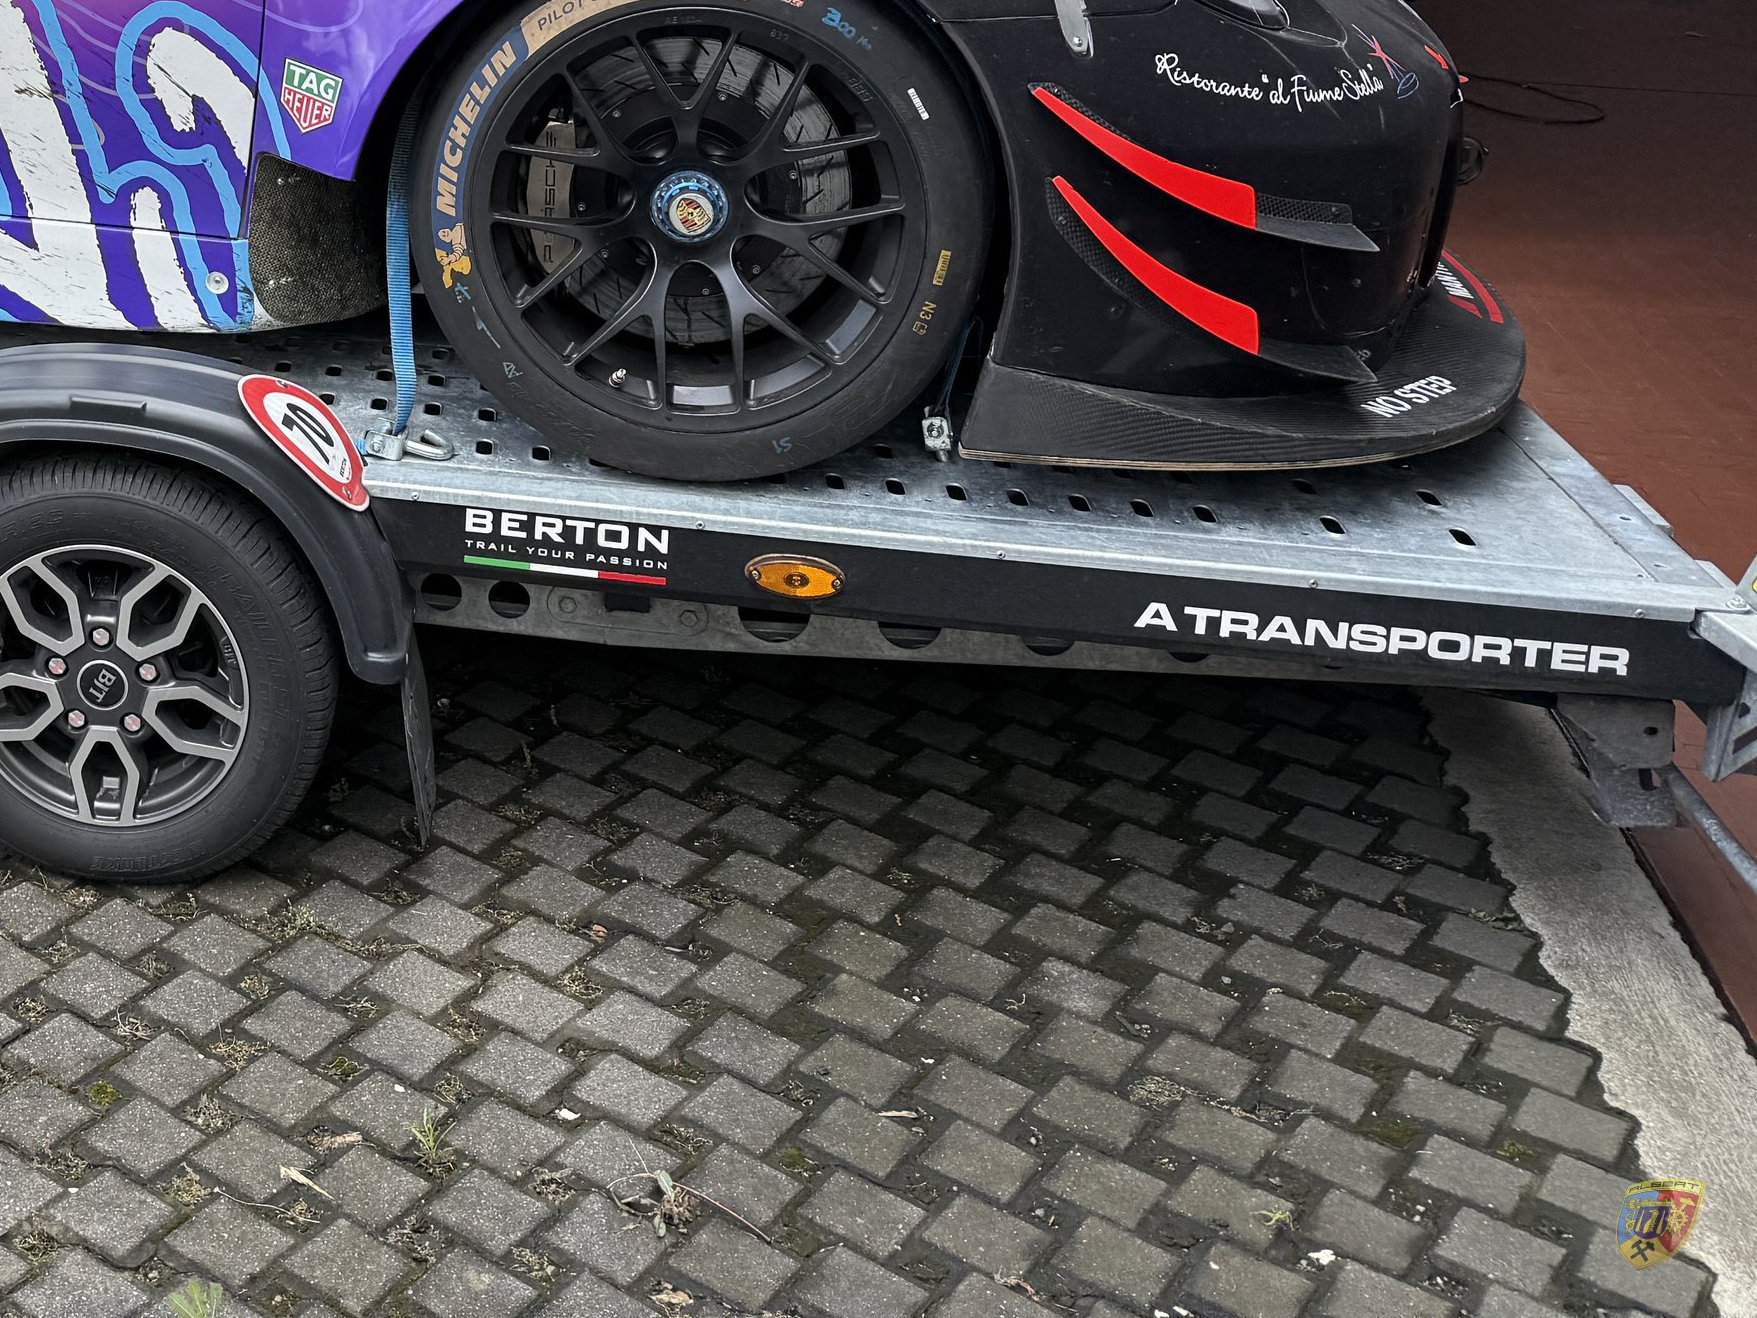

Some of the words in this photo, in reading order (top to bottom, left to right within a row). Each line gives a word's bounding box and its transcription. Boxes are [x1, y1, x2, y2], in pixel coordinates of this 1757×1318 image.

[289, 64, 336, 101] TAG
[1155, 53, 1263, 100] Ristorante
[1290, 74, 1344, 112] Fiume
[284, 89, 332, 127] HEUER
[435, 40, 517, 217] MICHELIN
[1361, 396, 1412, 418] NO
[1394, 375, 1457, 404] STEP
[282, 402, 335, 466] 70
[464, 507, 670, 555] BERTON
[464, 539, 517, 554] TRAIL
[526, 546, 576, 561] YOUR
[585, 553, 668, 570] PASSION
[1133, 601, 1179, 633] A
[1183, 606, 1630, 676] TRANSPORTER
[88, 668, 117, 703] BJT
